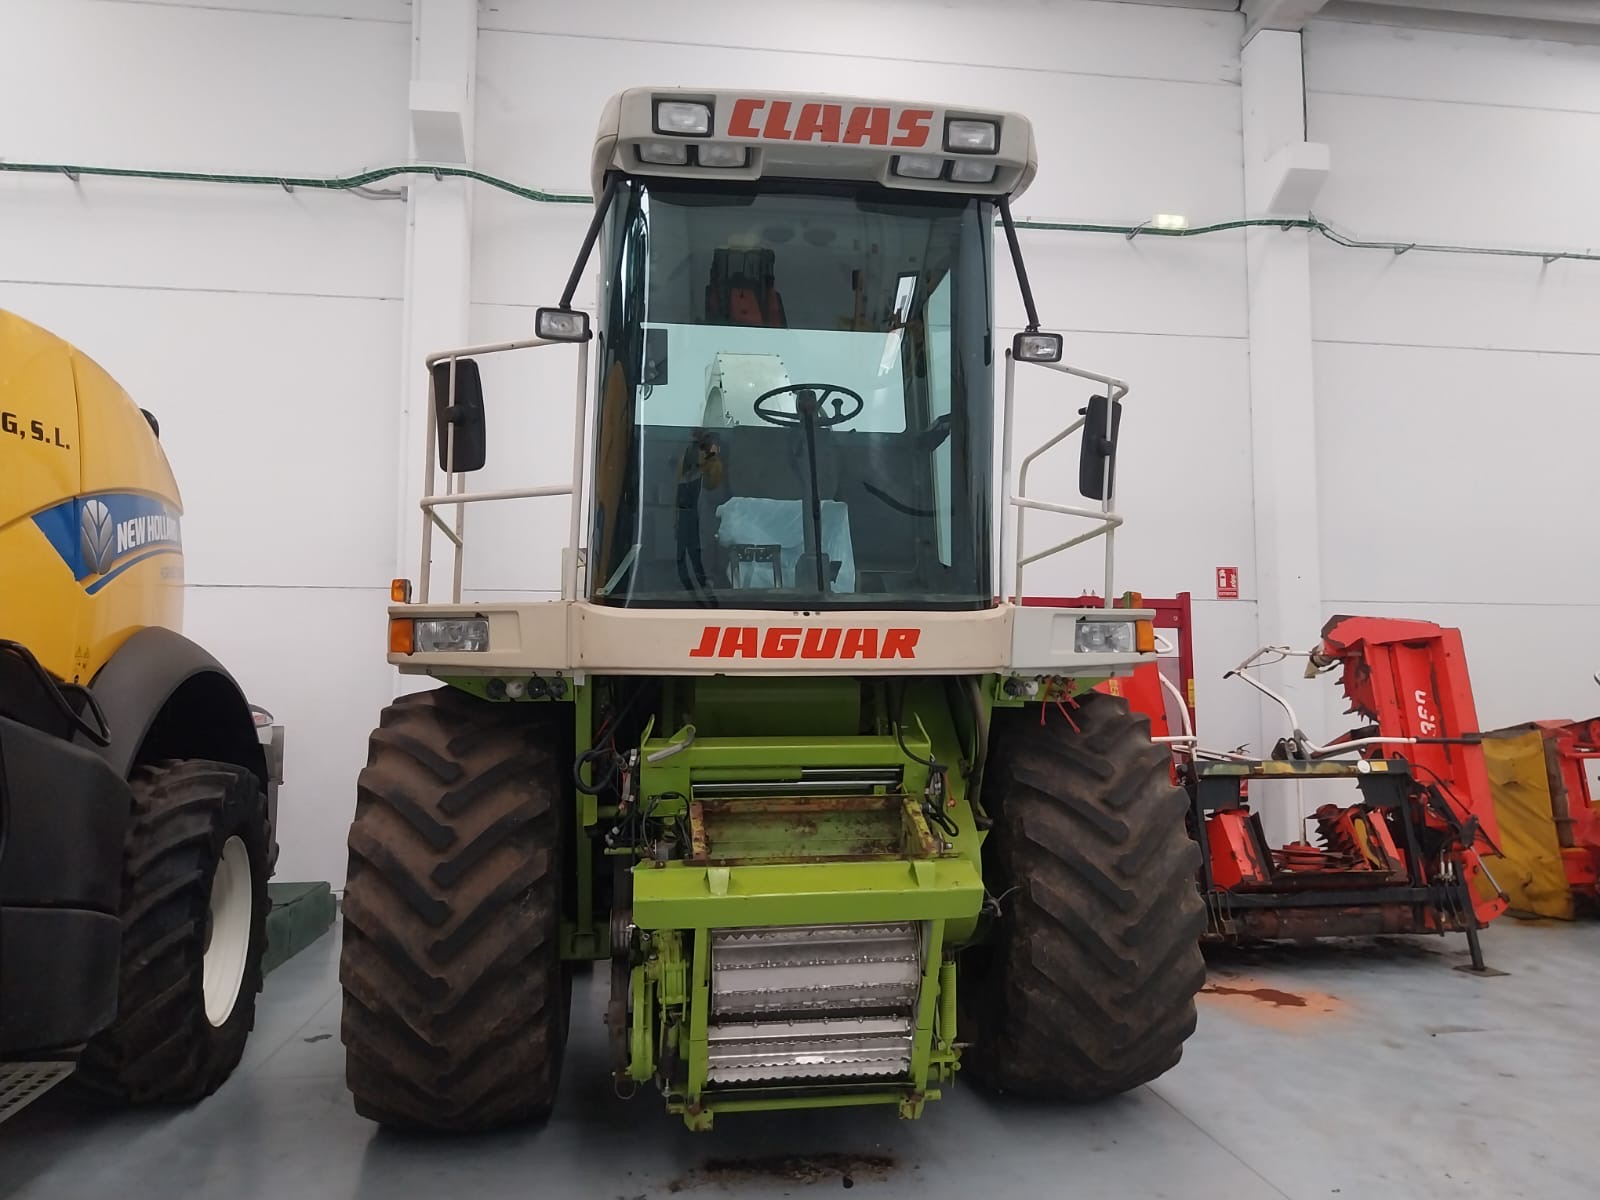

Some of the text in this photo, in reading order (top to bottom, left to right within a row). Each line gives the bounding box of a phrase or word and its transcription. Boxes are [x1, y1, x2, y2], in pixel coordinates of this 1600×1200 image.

[727, 98, 934, 148] CLAAS
[117, 516, 146, 554] NEW
[689, 626, 921, 659] JAGUAR
